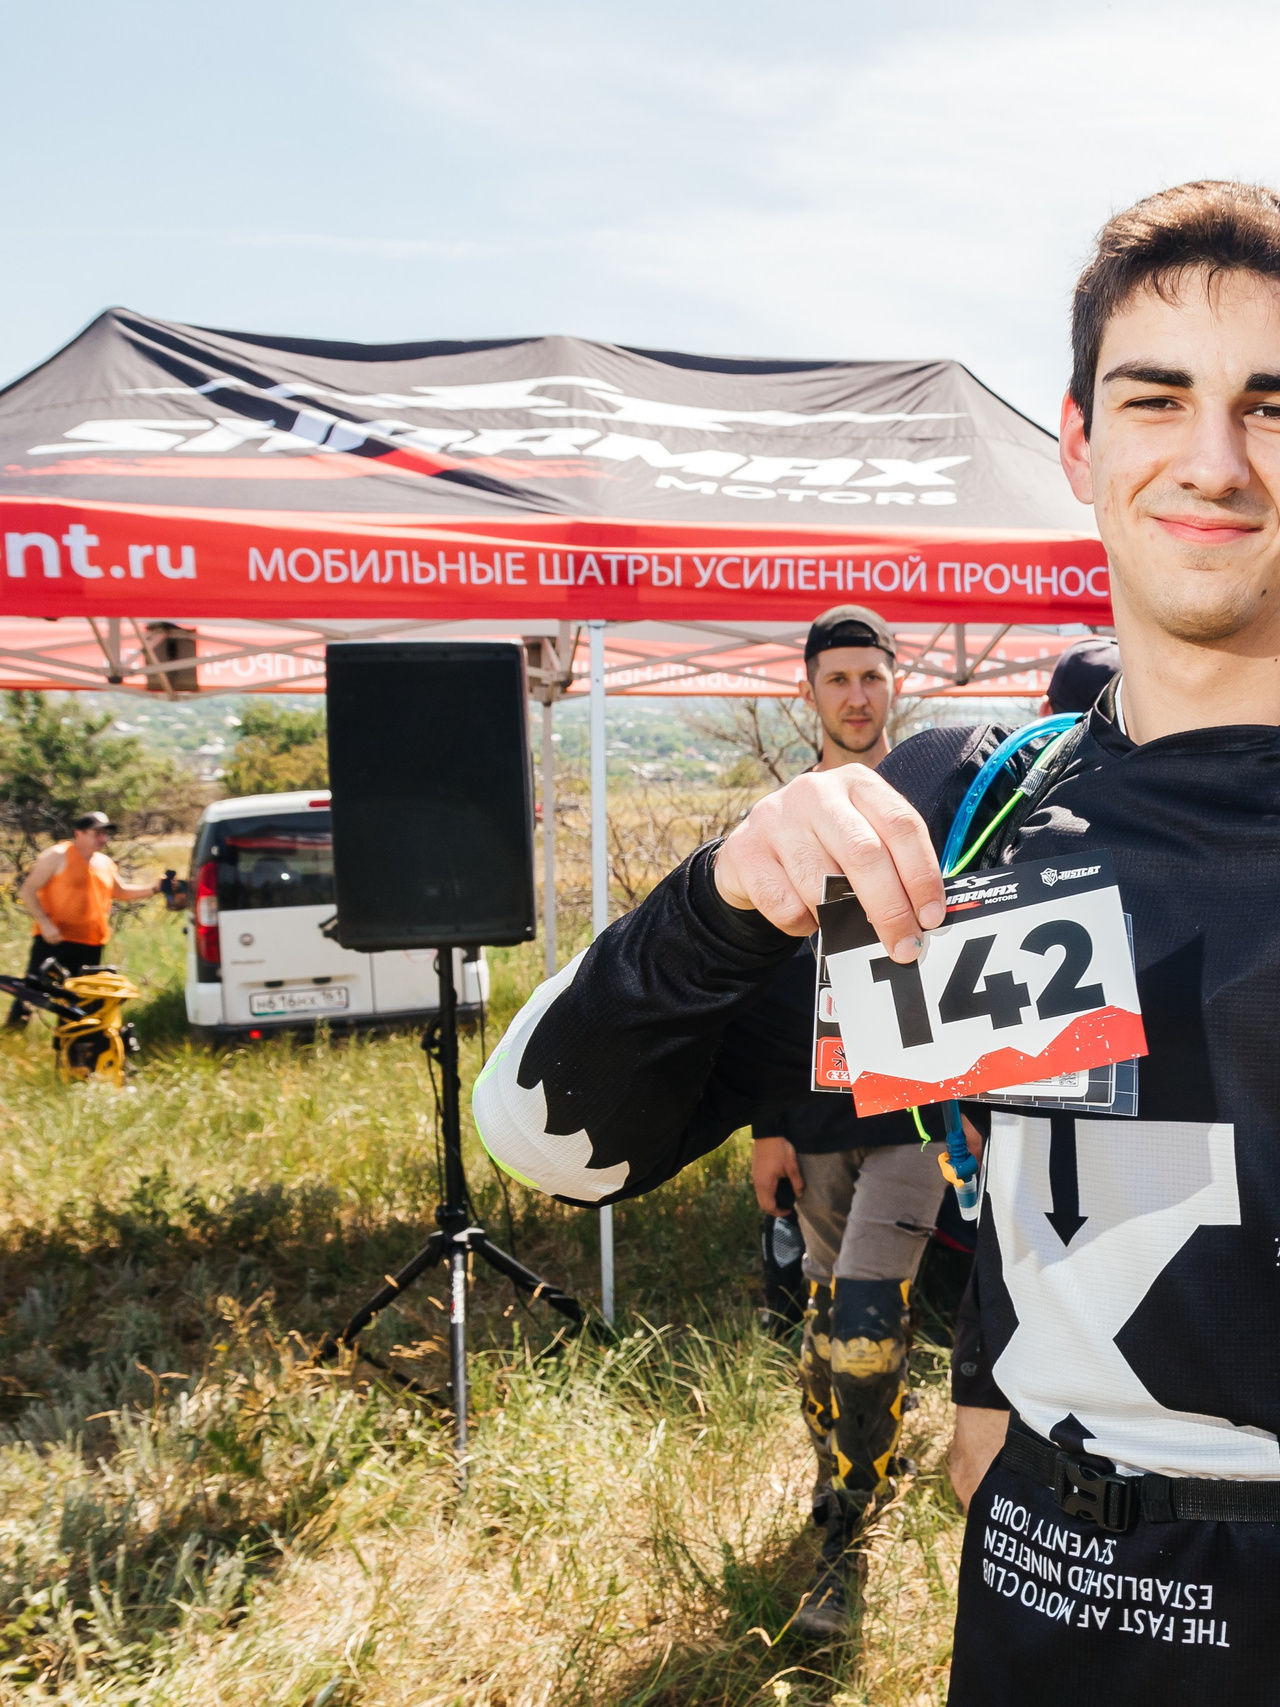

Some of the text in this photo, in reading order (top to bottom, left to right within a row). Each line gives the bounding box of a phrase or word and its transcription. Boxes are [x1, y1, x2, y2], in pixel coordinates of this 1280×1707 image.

[655, 474, 958, 506] MOTORS
[3, 523, 197, 580] nt.ru
[248, 546, 1109, 597] МОБИЛЬНЫЕ ШАТРЫ УСИЛЕННОЙ ПРОЧНОС
[946, 883, 1019, 905] HARMAX
[1058, 865, 1102, 880] JUSTCAT
[985, 894, 1019, 905] MOTORS
[868, 918, 1107, 1049] 142
[984, 1525, 1213, 1610] ESTABLISHED NINETEEN
[982, 1557, 1230, 1648] THE FAST AF MOTO CLUB
